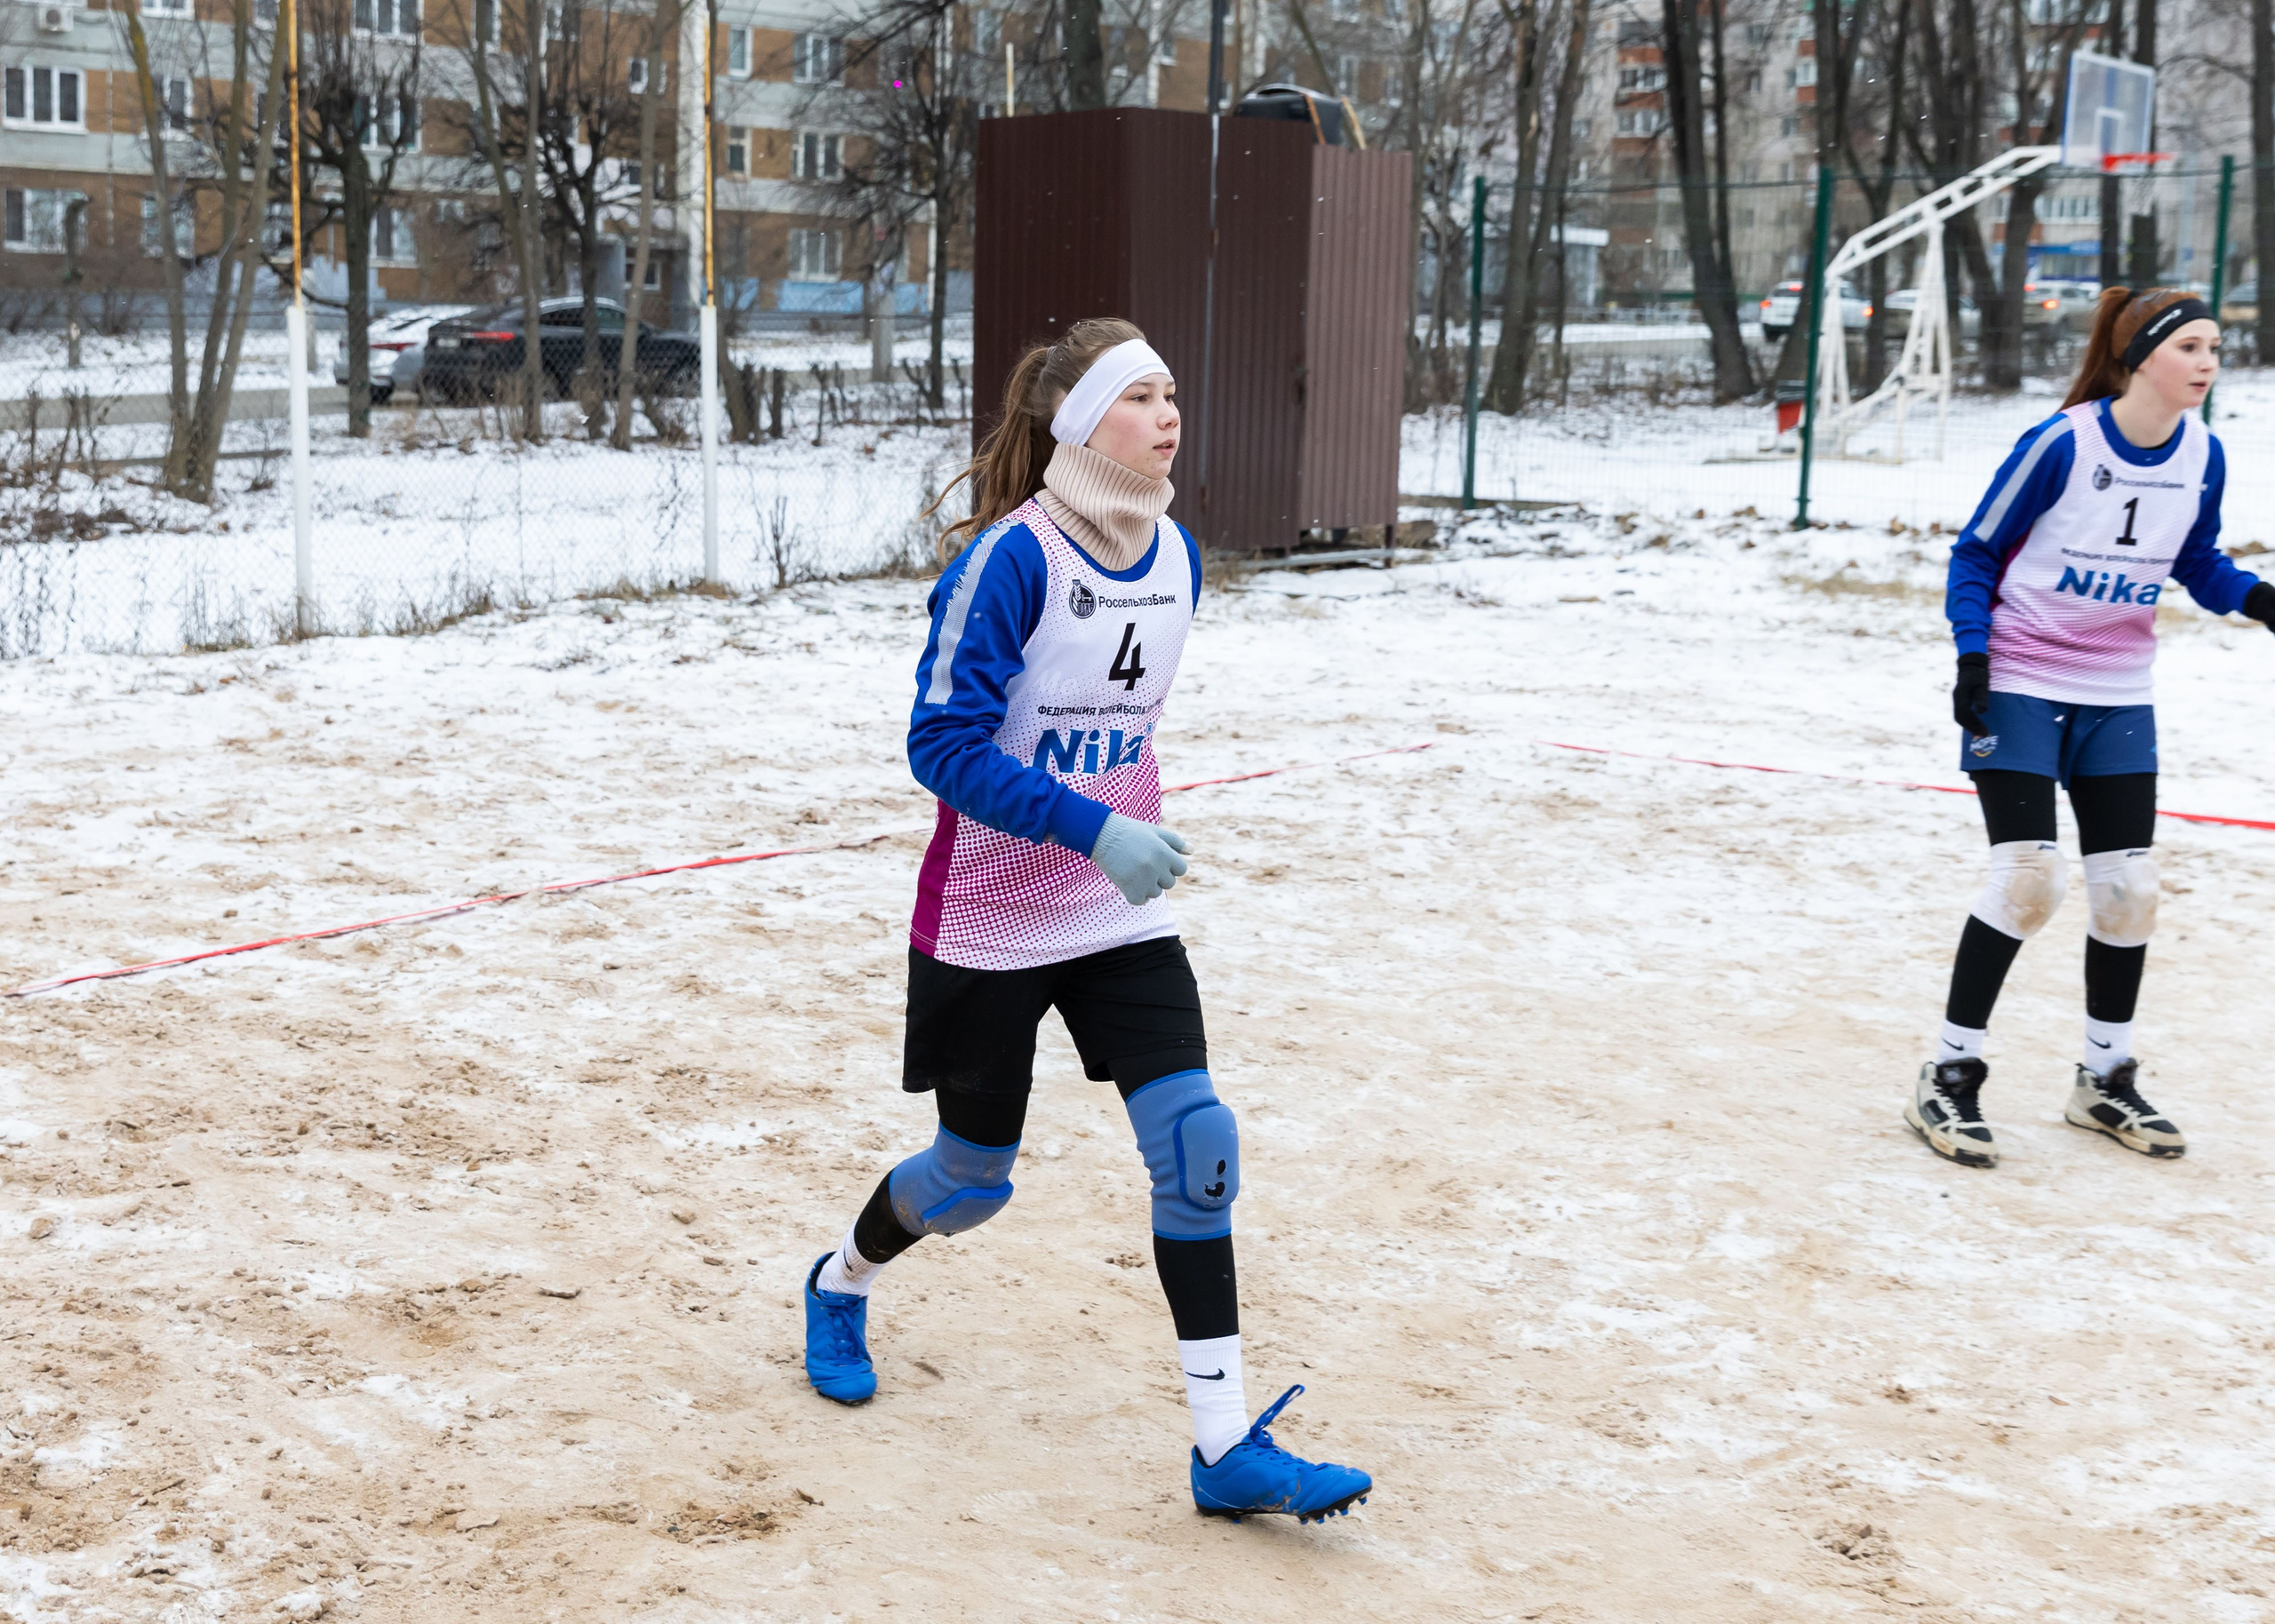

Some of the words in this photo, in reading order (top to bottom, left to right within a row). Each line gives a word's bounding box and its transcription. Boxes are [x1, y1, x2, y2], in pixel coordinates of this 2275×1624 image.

[2115, 498, 2140, 545] 1
[1098, 593, 1177, 609] РоссельхозБанк
[2055, 566, 2162, 605] Nika
[1108, 623, 1145, 690] 4
[1037, 705, 1097, 716] ФЕДЕРАЦИЯ
